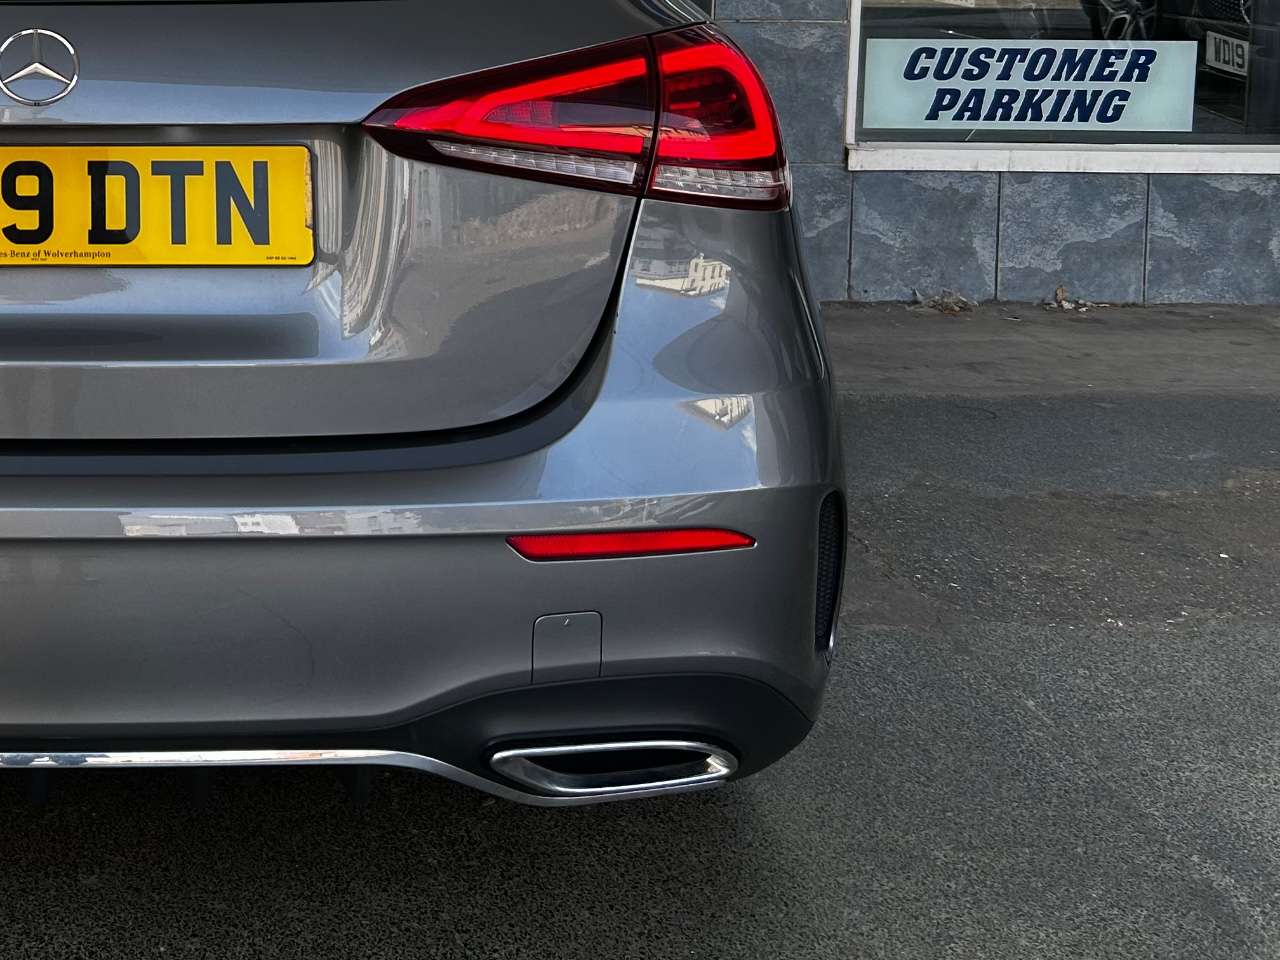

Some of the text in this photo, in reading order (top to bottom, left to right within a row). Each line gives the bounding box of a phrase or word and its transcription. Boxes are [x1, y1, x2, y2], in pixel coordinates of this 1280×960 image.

[903, 46, 1158, 83] CUSTOMER
[924, 87, 1132, 124] PARKING
[87, 160, 271, 246] DTN
[32, 248, 42, 258] of
[43, 248, 112, 260] Wolverhampton
